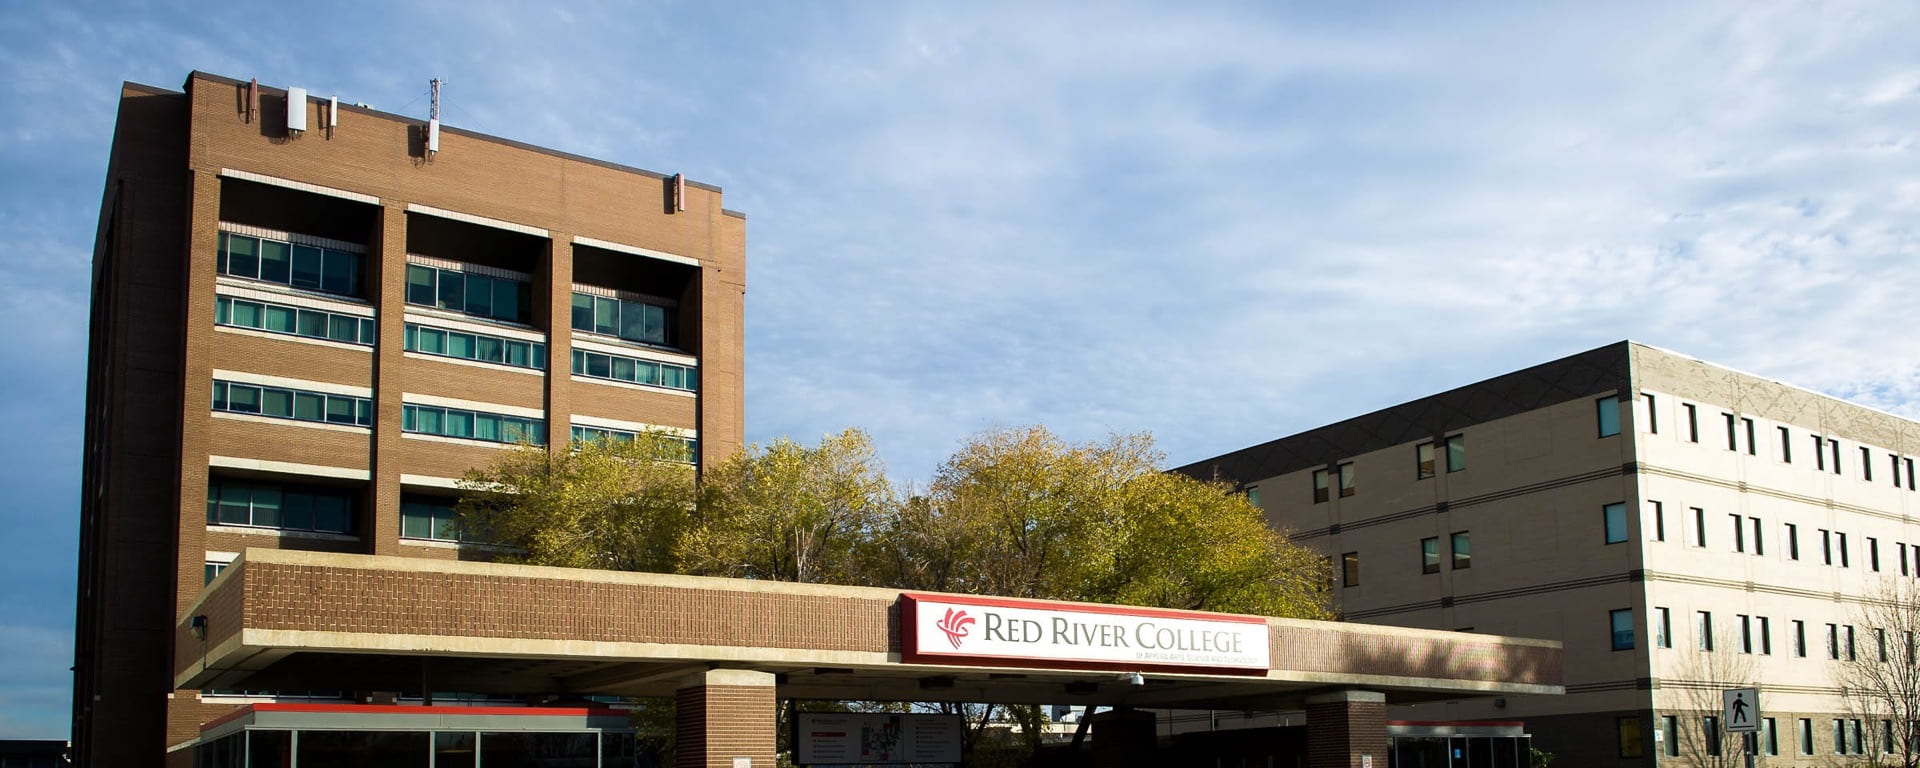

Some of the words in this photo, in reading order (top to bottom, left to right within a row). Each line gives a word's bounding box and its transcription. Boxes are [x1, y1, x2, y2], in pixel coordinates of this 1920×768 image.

[984, 612, 1043, 643] RED
[1051, 617, 1131, 648] RIVER
[1135, 622, 1243, 653] COLLEGE
